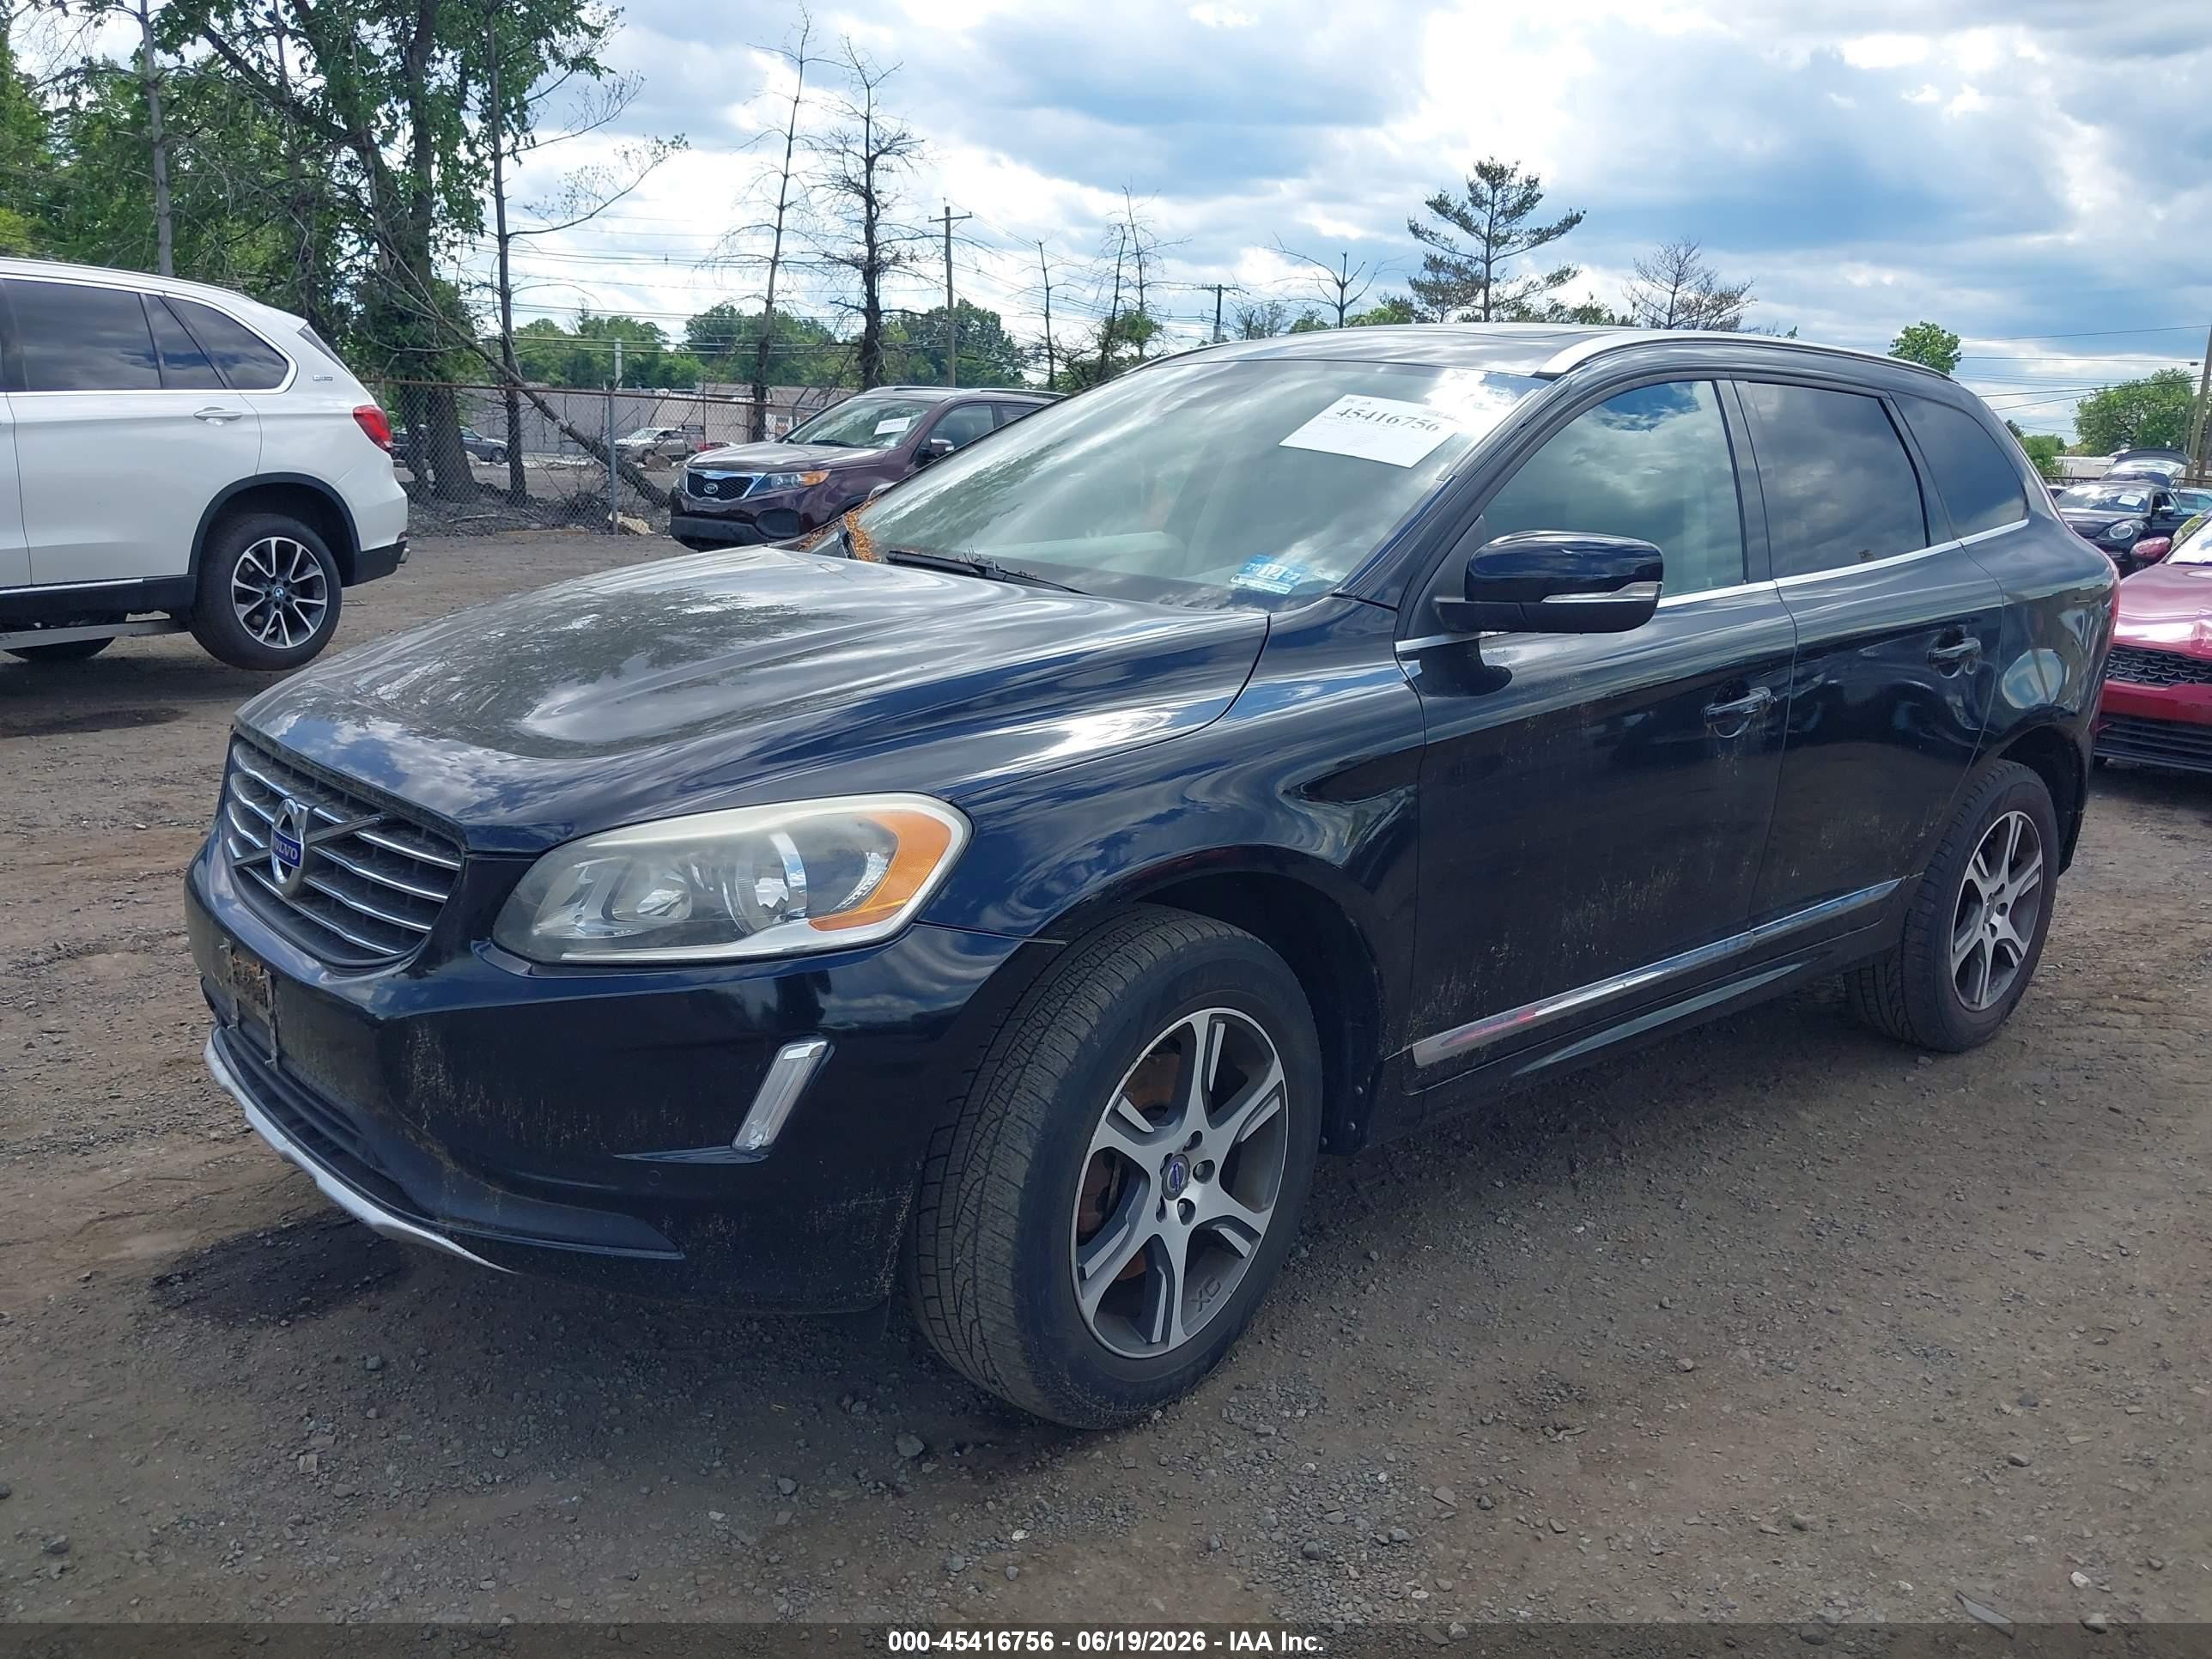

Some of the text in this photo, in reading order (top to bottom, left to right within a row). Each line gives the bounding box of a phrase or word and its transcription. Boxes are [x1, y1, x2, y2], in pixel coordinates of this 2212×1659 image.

[1336, 408, 1443, 431] 45416756
[1261, 565, 1282, 578] 12
[1190, 1277, 1221, 1312] XC
